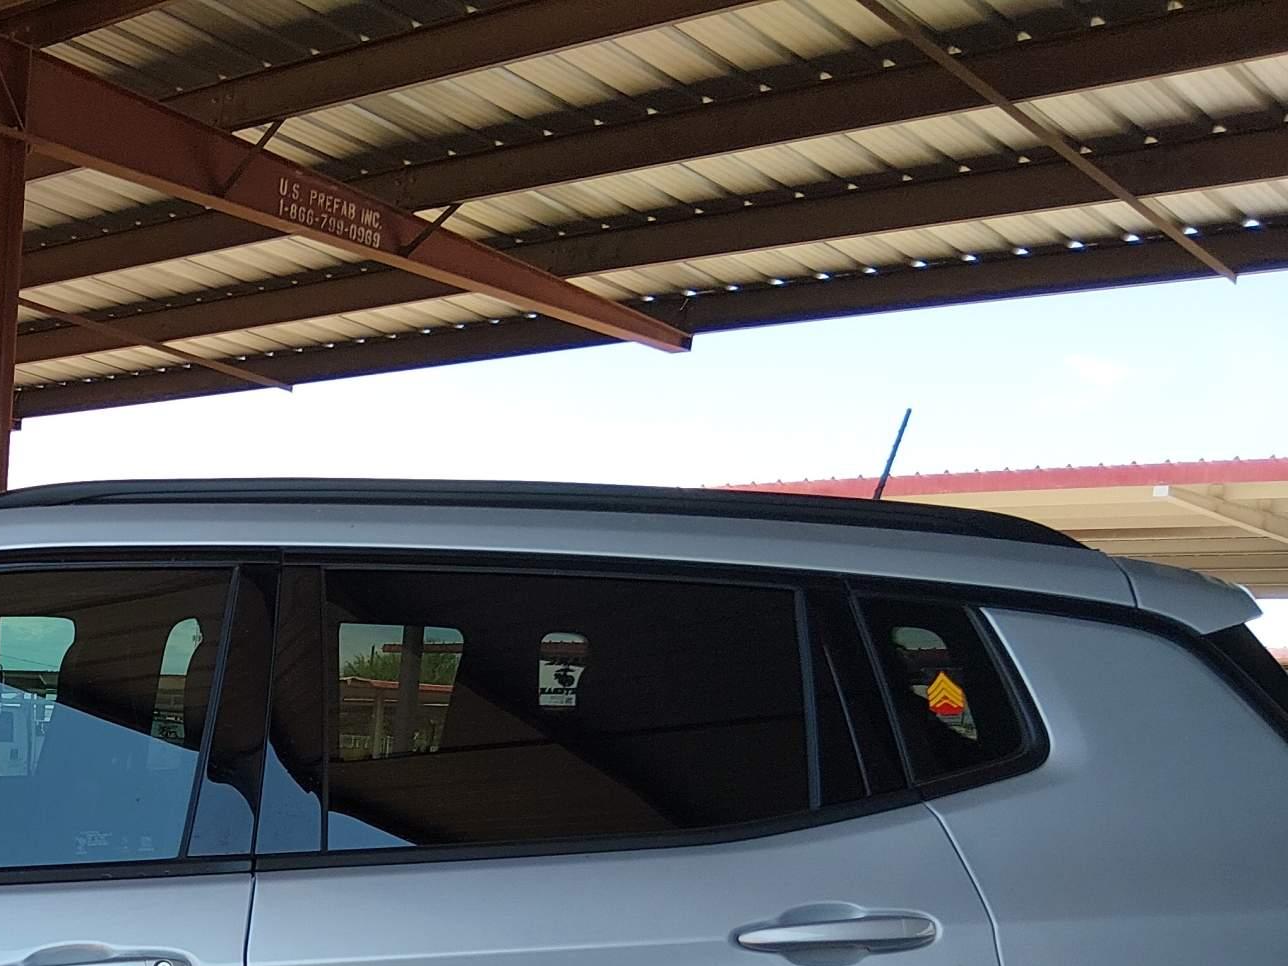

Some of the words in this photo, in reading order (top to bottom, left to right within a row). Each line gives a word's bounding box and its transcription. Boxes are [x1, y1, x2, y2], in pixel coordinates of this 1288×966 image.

[279, 177, 304, 202] U.S.
[309, 190, 356, 220] PREFAB
[361, 207, 383, 230] INC.
[279, 198, 381, 249] 1-866-799-0969
